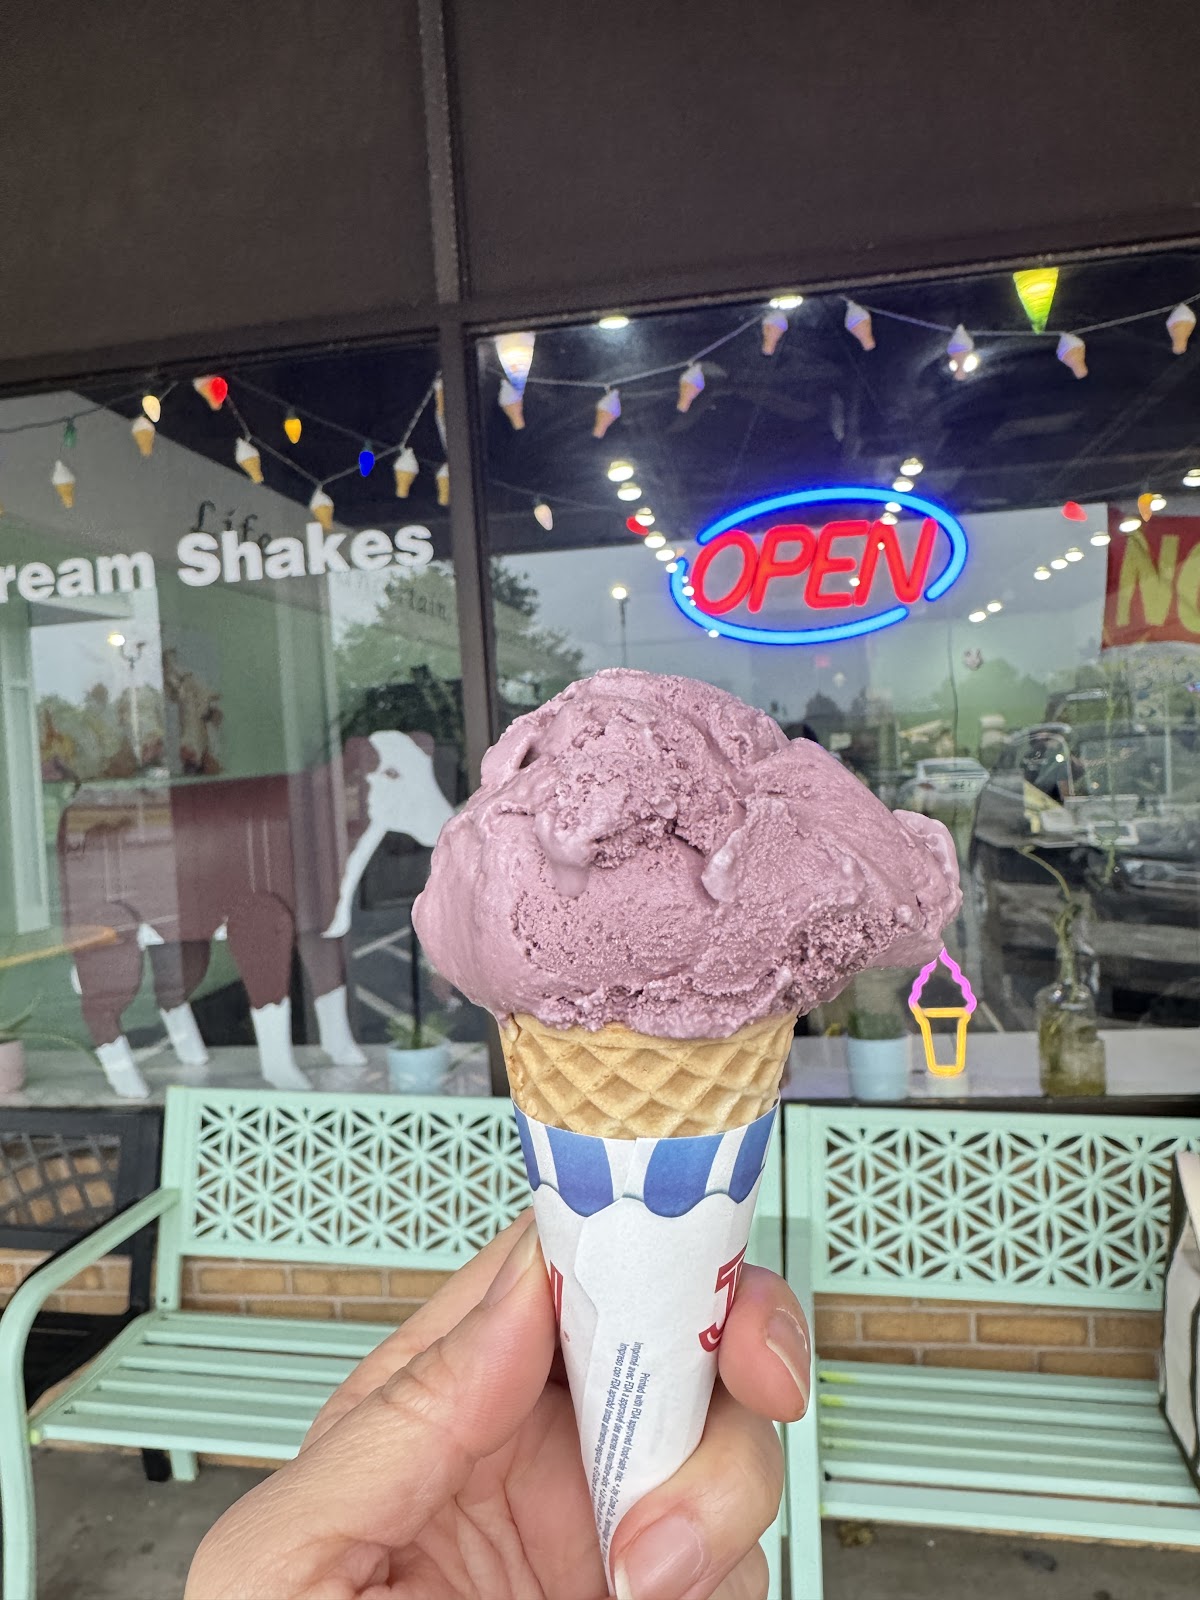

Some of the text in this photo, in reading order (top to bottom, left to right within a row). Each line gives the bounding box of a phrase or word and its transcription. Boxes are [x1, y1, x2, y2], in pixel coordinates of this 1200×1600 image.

[176, 522, 435, 587] Shakes
[690, 517, 939, 616] OPEN
[626, 1366, 636, 1380] avec
[609, 1377, 621, 1390] FDA
[622, 1380, 634, 1393] FDA
[637, 1372, 651, 1394] Printed
[633, 1394, 644, 1407] with
[631, 1407, 643, 1420] FDA
[624, 1419, 637, 1446] approved
